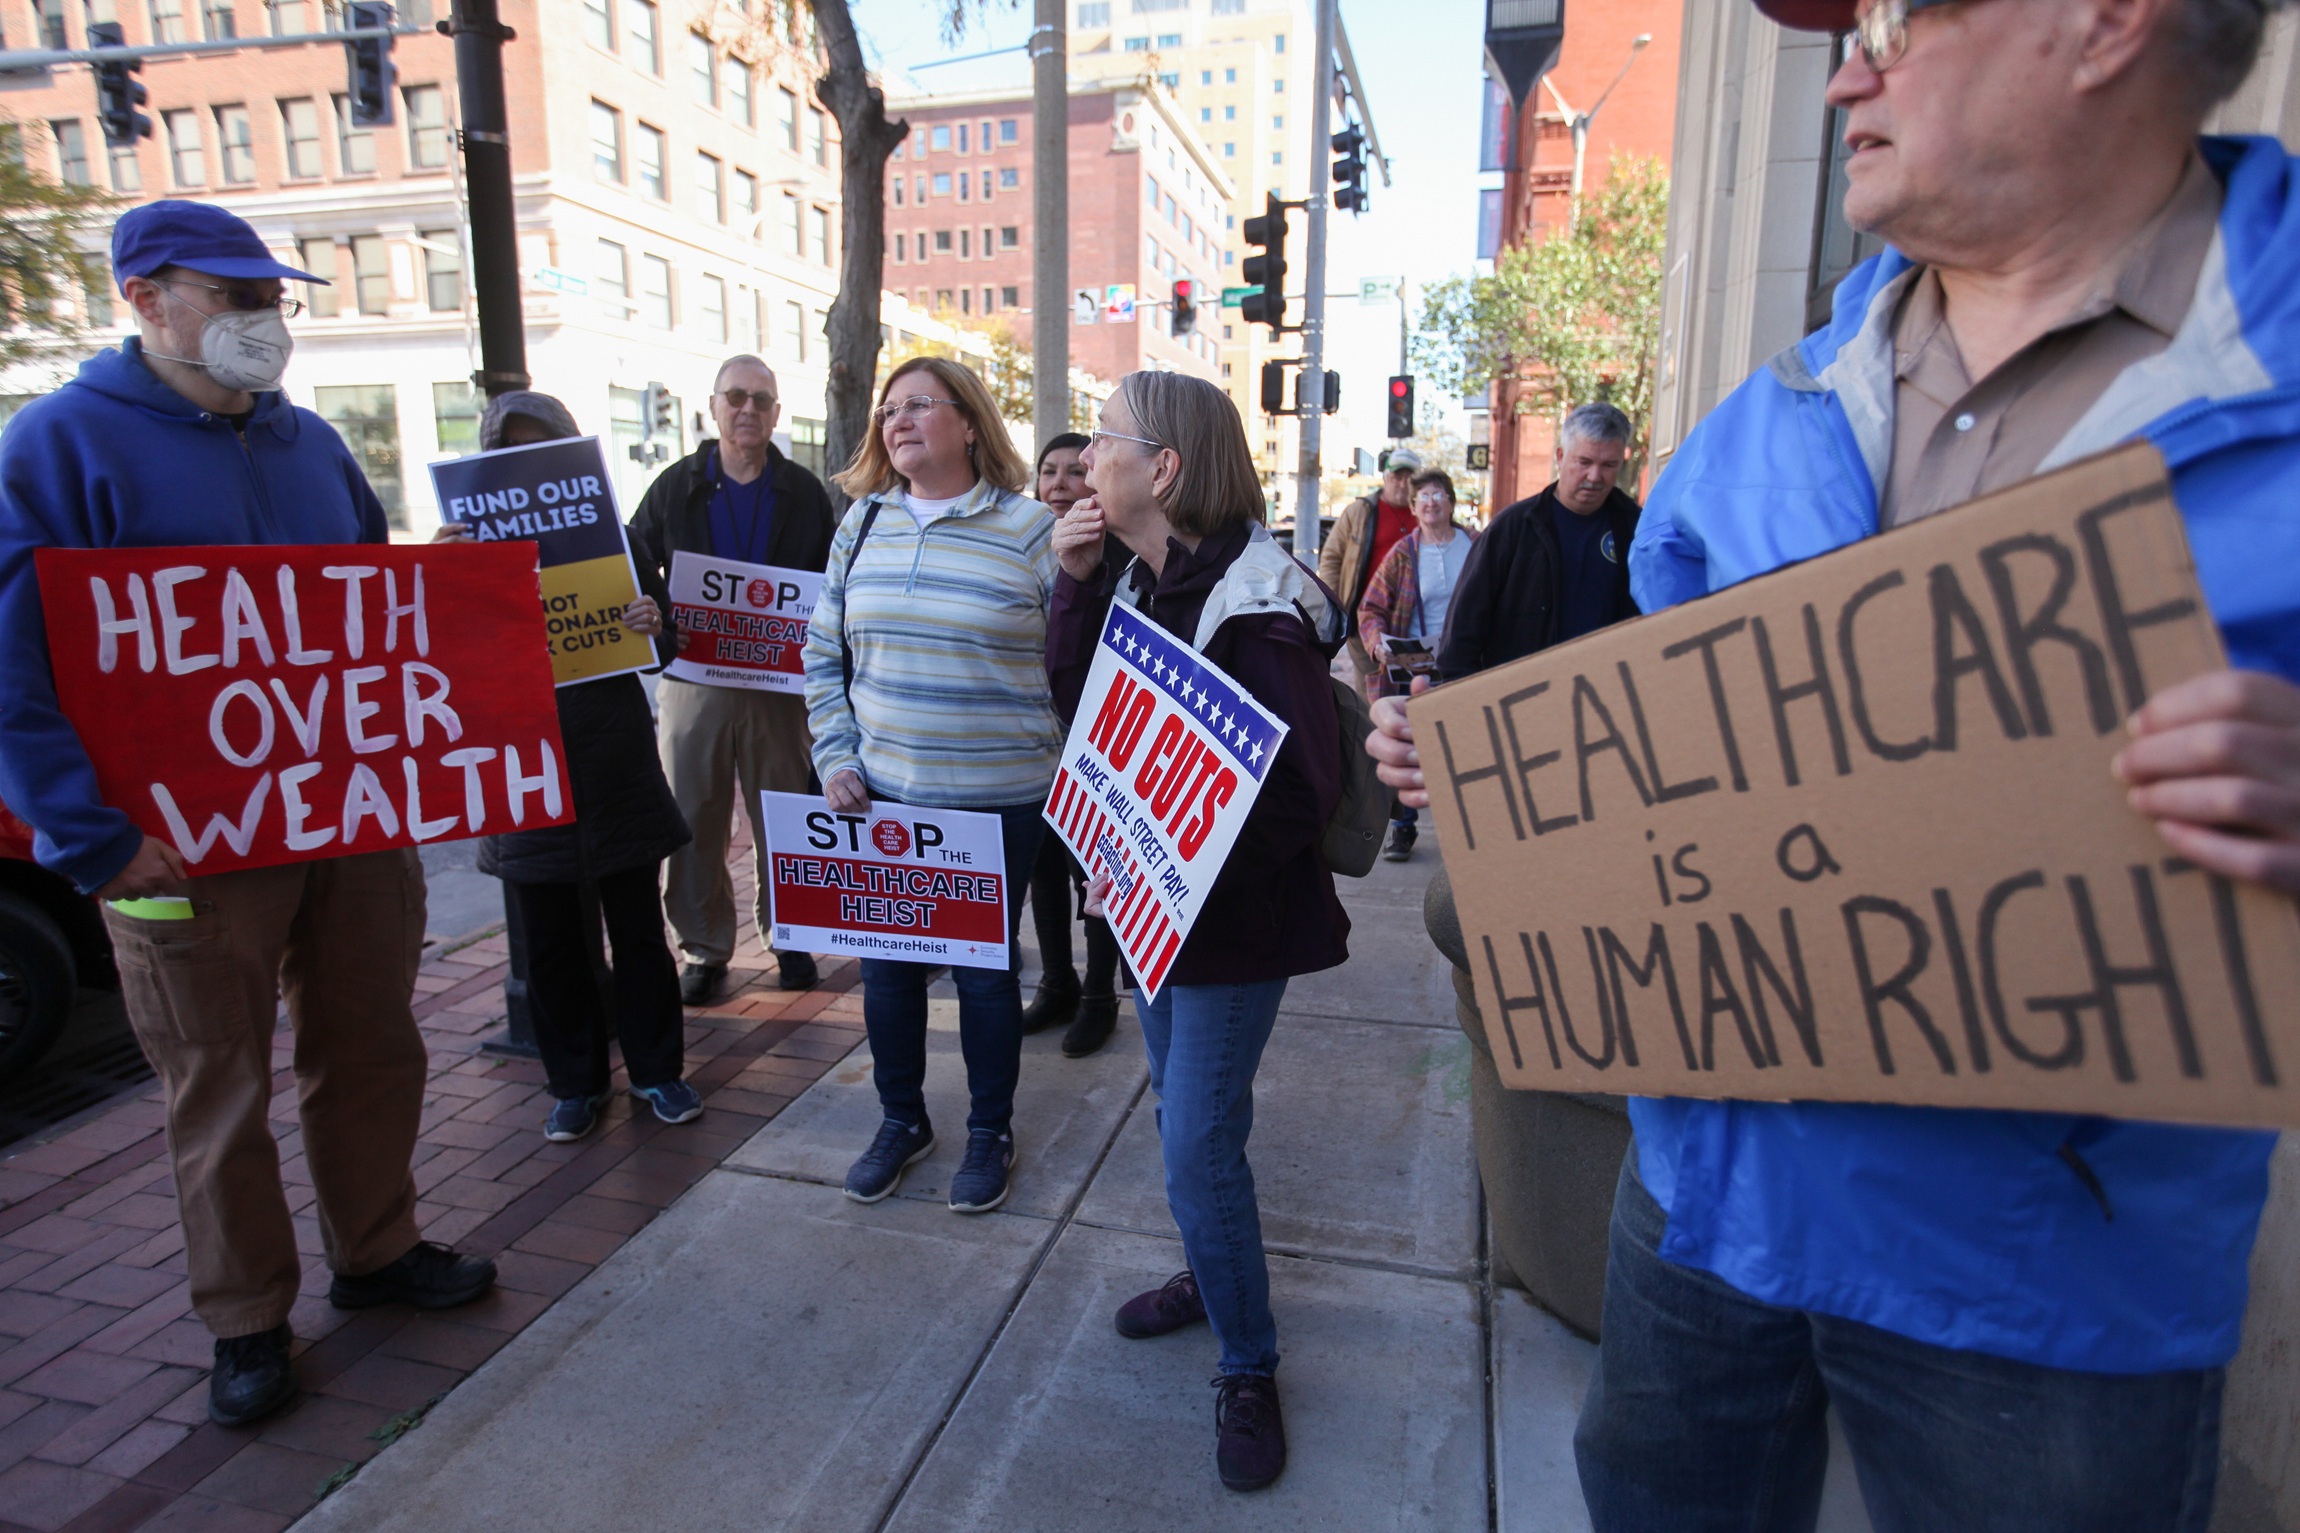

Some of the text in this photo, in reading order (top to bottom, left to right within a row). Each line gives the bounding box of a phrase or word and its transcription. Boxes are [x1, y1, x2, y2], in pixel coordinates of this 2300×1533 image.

[450, 475, 603, 520] FUND OUR
[89, 562, 430, 677] HEALTH
[546, 603, 631, 635] ONAIR
[562, 627, 622, 653] CUTS
[673, 606, 809, 643] HEALTHCA
[717, 638, 784, 665] HEIST
[1434, 478, 2198, 852] HEALTHCARE
[705, 668, 789, 685] #HealthcareHeist
[209, 660, 463, 769] OVER
[1087, 668, 1239, 863] NO CUTS
[150, 737, 563, 865] WEALTH
[1074, 752, 1190, 908] MAKE WALL STREET PAY!
[778, 857, 999, 903] HEALTHCARE
[939, 849, 973, 865] THE
[1096, 833, 1134, 901] cciaction.org
[1644, 822, 1843, 907] is a
[841, 894, 937, 928] HEIST
[830, 933, 948, 954] #HealthcareHeist
[1482, 857, 2281, 1088] HUMAN RIGHT
